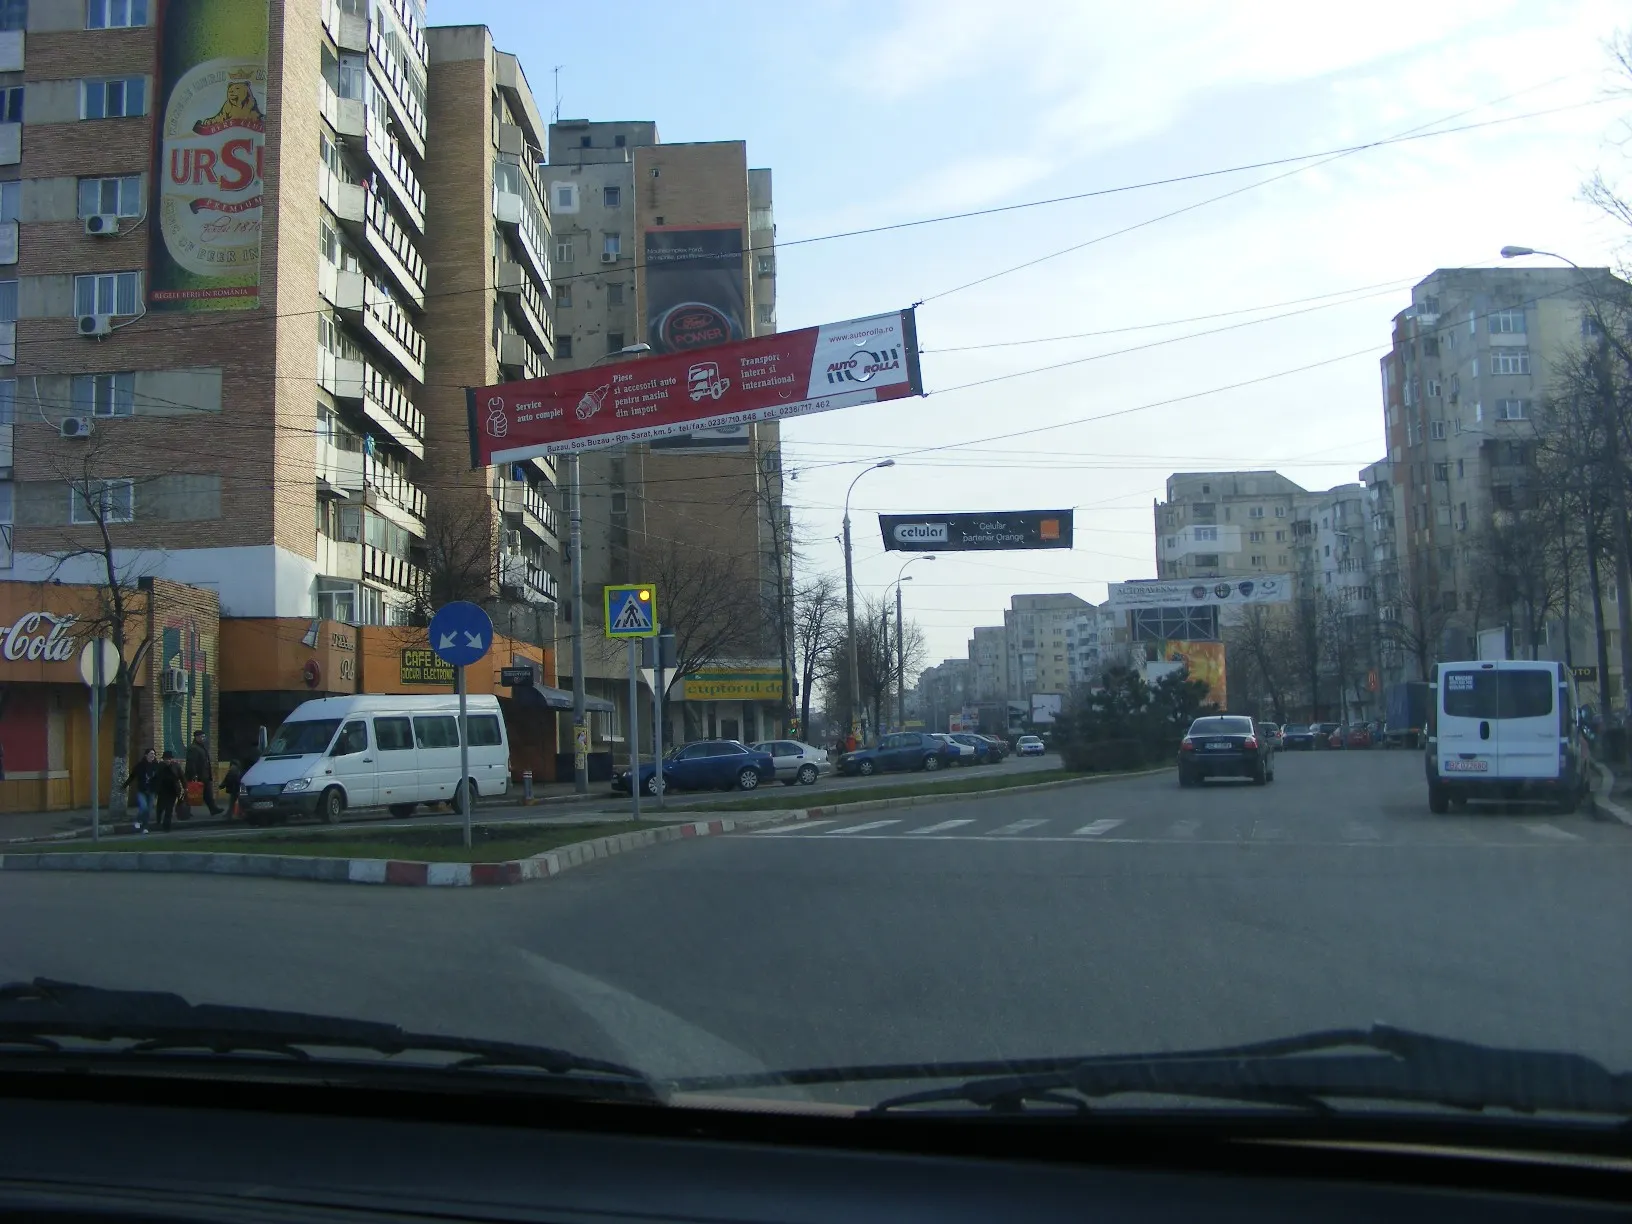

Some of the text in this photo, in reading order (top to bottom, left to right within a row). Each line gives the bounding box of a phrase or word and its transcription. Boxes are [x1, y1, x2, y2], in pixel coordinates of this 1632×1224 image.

[206, 197, 262, 213] PREMIUM
[197, 248, 237, 262] BEER
[829, 326, 894, 343] www.autorolla.ro
[740, 354, 780, 367] Transport
[827, 359, 858, 372] AUTO
[863, 360, 900, 375] ROLLA
[769, 364, 777, 374] si
[612, 374, 633, 383] Piese
[742, 373, 795, 390] international
[614, 377, 677, 395] si accesorii auto
[516, 400, 542, 412] Service
[615, 389, 669, 409] pentru masini
[517, 408, 564, 424] auto complet
[616, 404, 657, 418] din import
[547, 442, 570, 453] Buzau,
[571, 440, 587, 449] Sos.
[587, 436, 610, 447] Buzau
[631, 430, 653, 440] Sarat,
[653, 428, 666, 438] km.
[815, 400, 830, 409] 462
[901, 526, 943, 538] celular
[979, 521, 1007, 531] Celular
[963, 533, 1024, 543] partener Orange
[405, 651, 432, 666] CAFE
[1570, 668, 1591, 676] UTO
